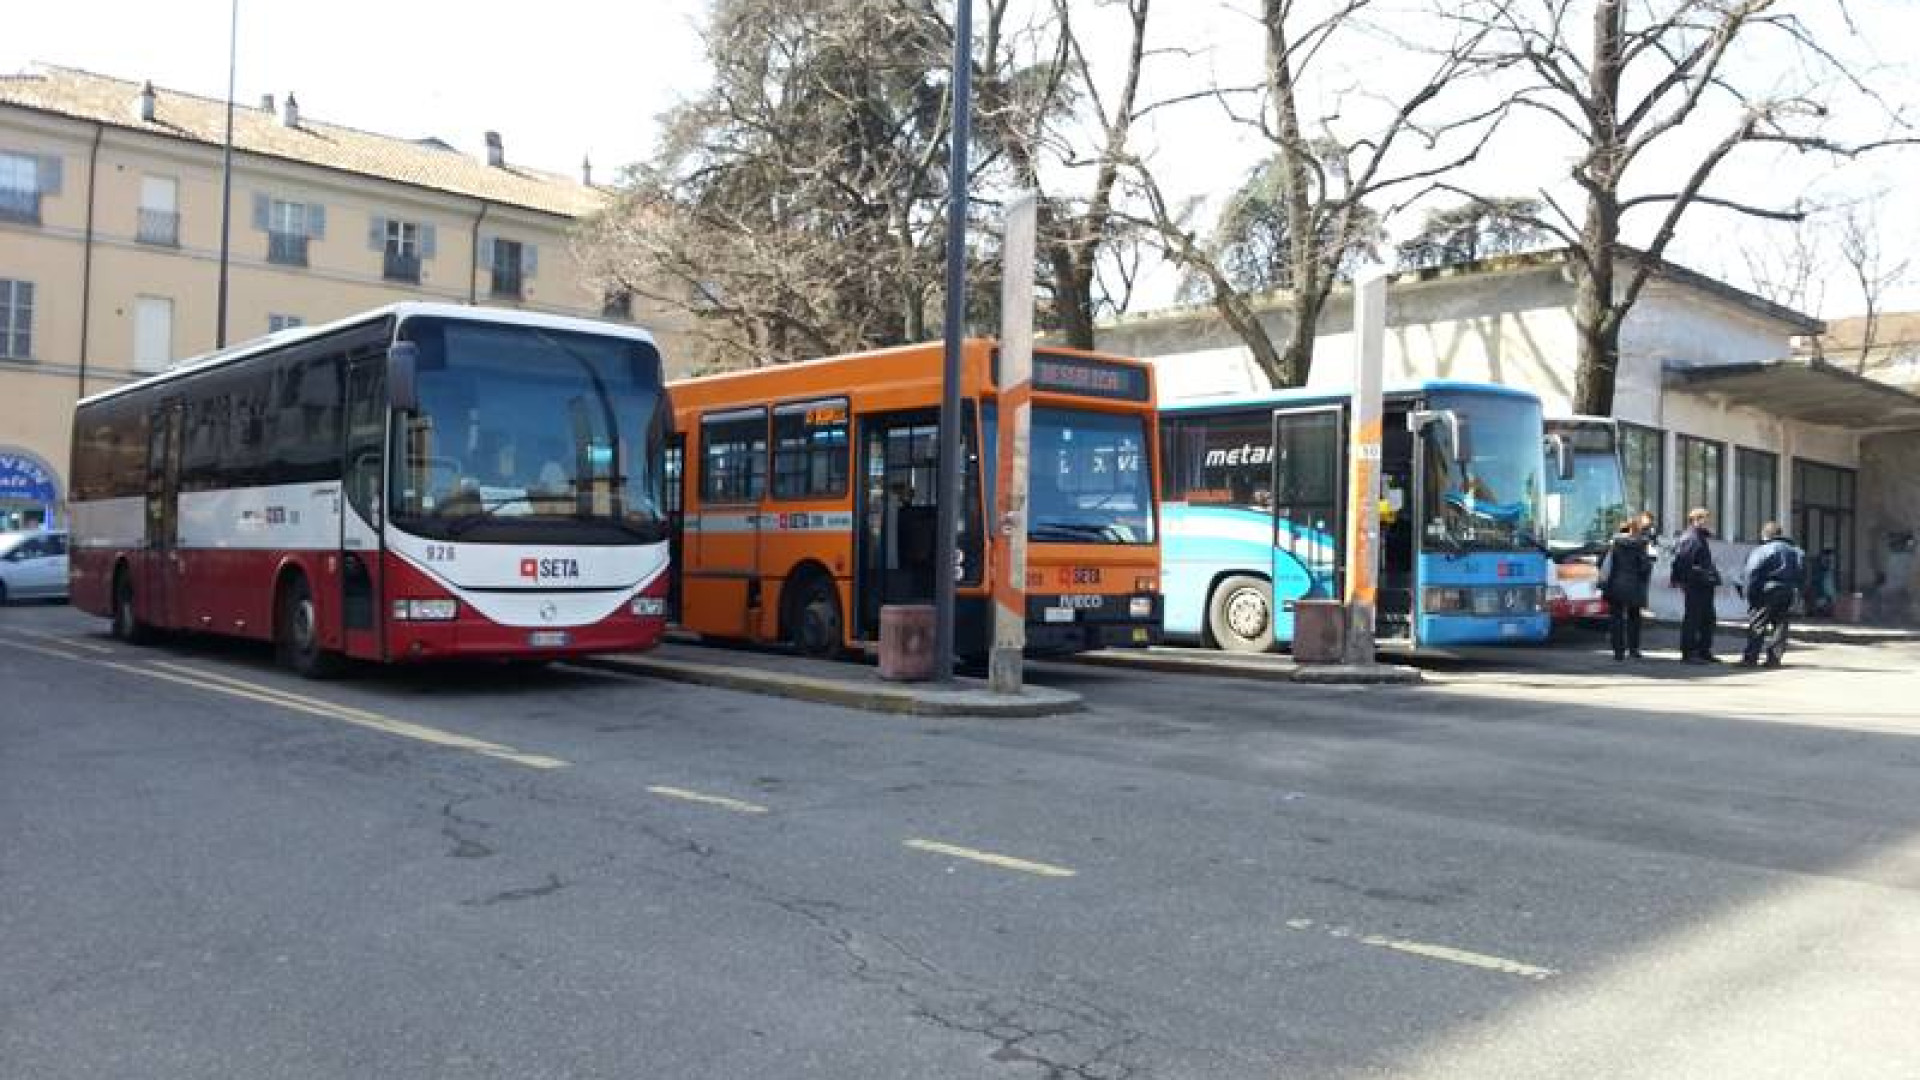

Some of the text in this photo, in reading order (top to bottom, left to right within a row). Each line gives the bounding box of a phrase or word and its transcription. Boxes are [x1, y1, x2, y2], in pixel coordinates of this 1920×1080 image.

[539, 558, 579, 578] SETA
[1073, 568, 1101, 584] SETA
[1060, 594, 1103, 608] IVECO
